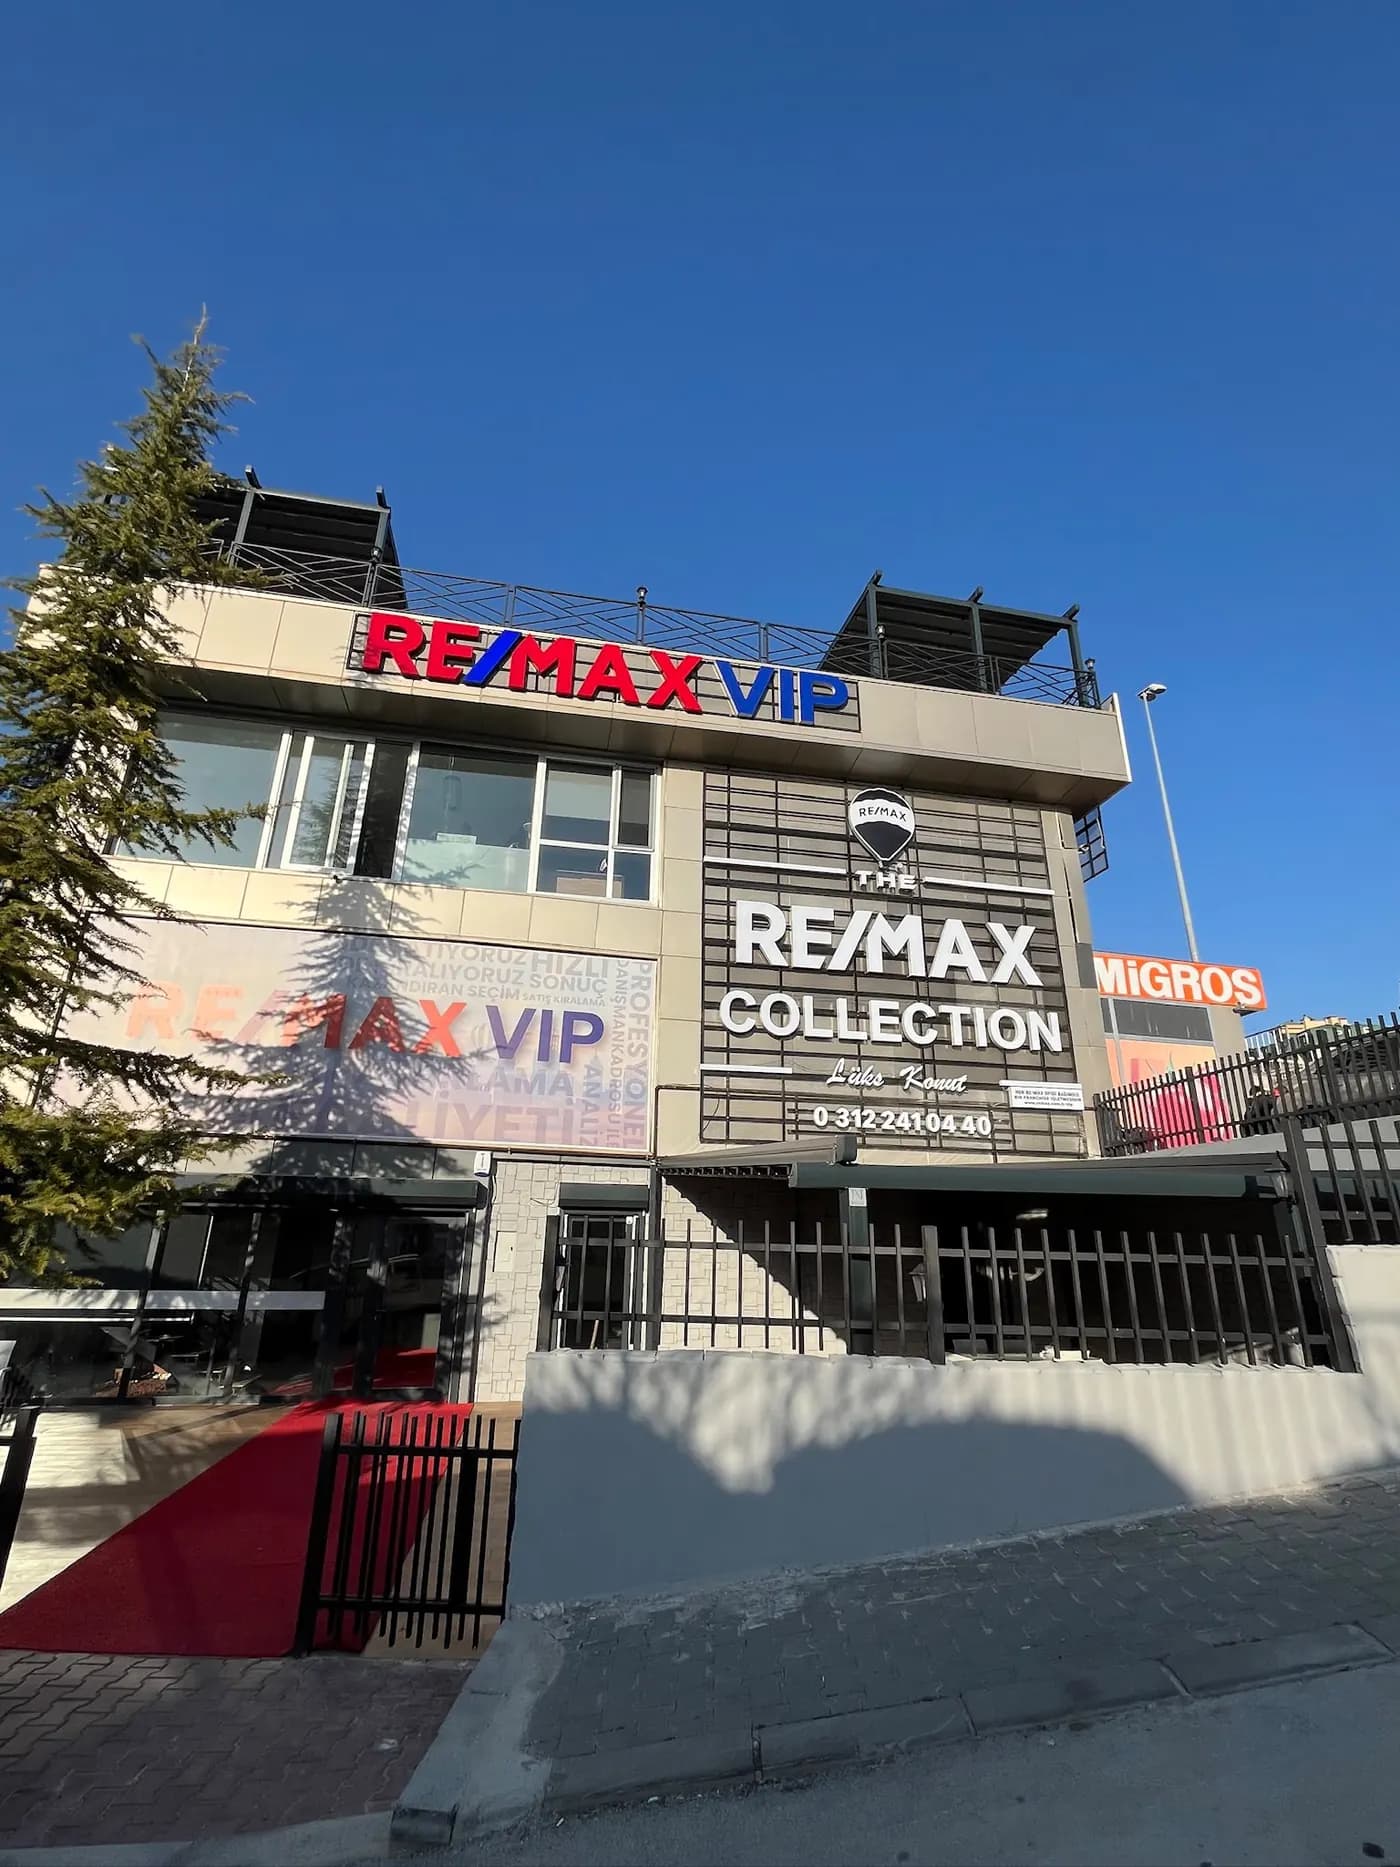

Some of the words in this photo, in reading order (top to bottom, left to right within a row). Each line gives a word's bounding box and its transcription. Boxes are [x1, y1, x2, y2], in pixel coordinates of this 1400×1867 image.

[362, 611, 703, 714] RE/MAX
[714, 659, 850, 725] VIP
[859, 806, 906, 822] RE/MAX
[855, 870, 917, 890] THE
[736, 900, 1044, 987] RE/MAX
[531, 952, 608, 979] HIZLI
[467, 984, 520, 1002] SEÇİM
[530, 973, 608, 998] SONUÇ
[486, 1004, 605, 1064] VIP
[719, 990, 1062, 1052] COLLECTION
[623, 961, 652, 1148] PROFESYONEL
[826, 1057, 885, 1087] Lüks
[899, 1064, 968, 1093] Konut
